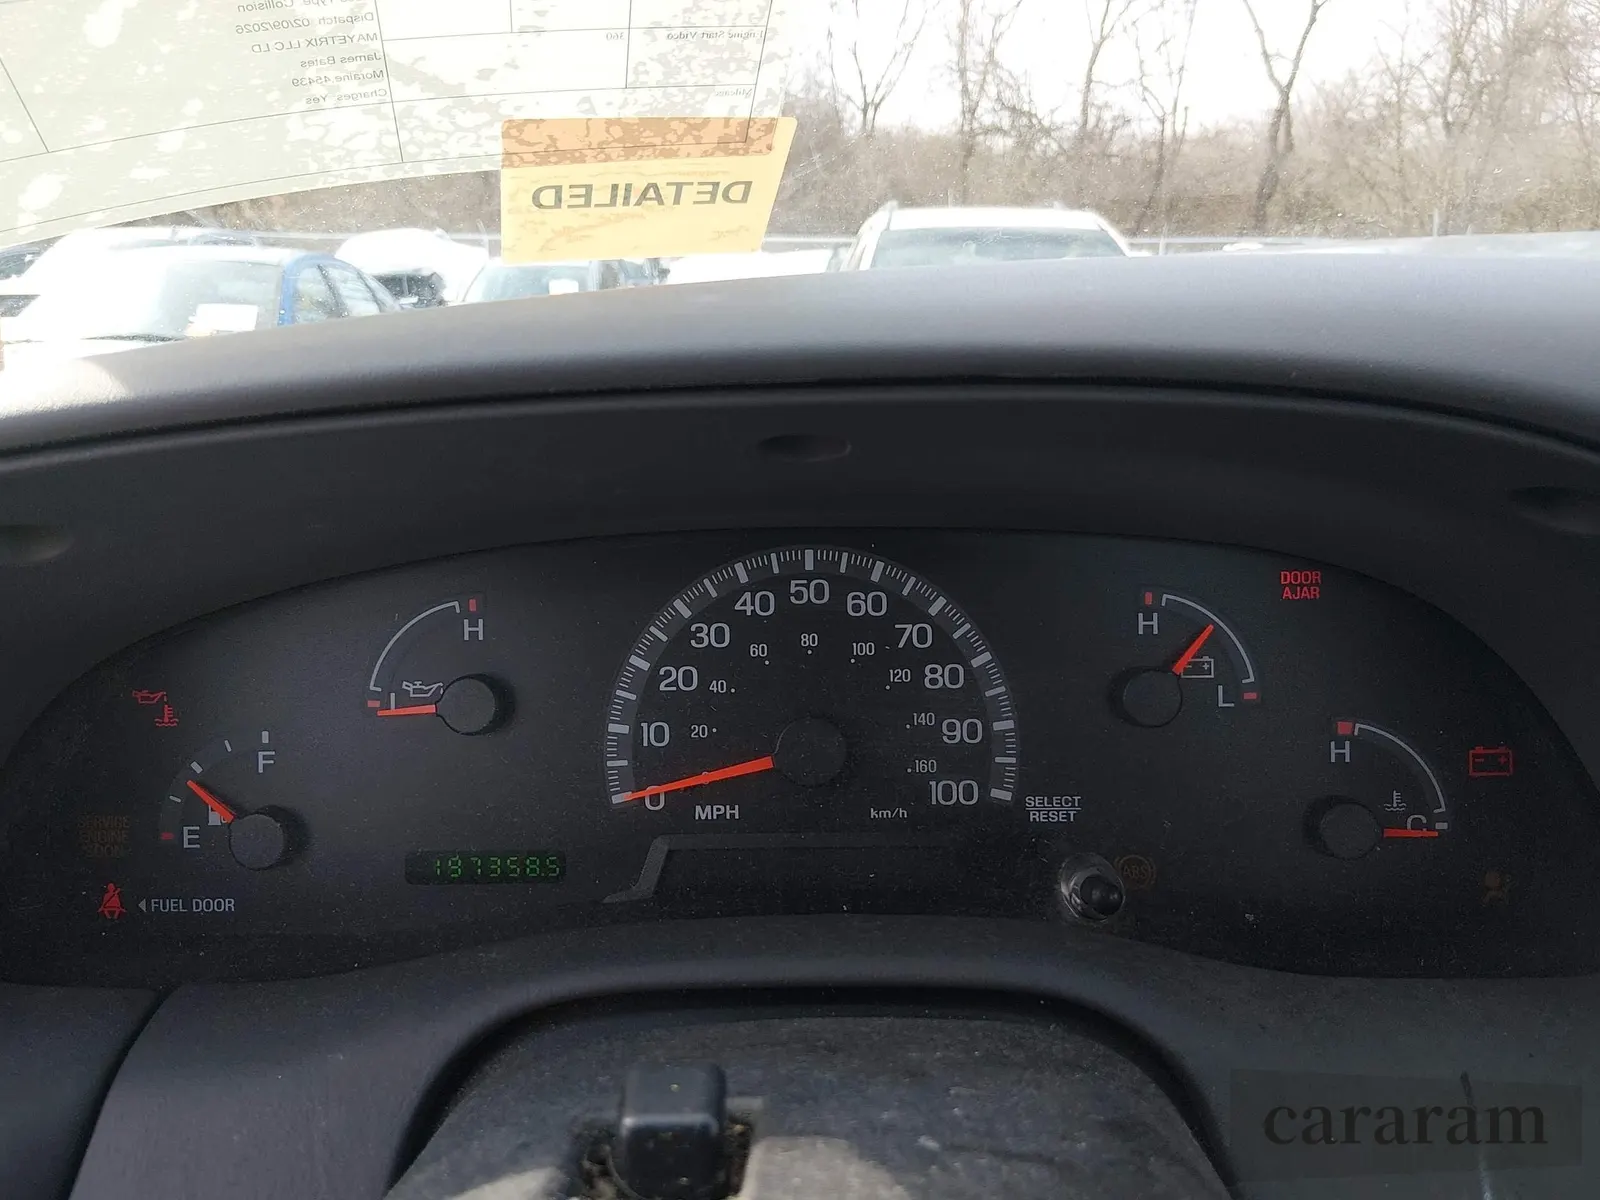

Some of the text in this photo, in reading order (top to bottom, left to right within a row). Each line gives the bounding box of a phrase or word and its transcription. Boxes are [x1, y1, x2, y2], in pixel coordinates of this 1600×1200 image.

[1280, 571, 1321, 584] DOOR
[789, 579, 830, 604] 50
[1282, 586, 1320, 599] AJAR
[734, 591, 775, 616] 40
[846, 591, 887, 617] 60
[463, 618, 483, 640] H
[1138, 612, 1158, 634] H
[690, 622, 730, 648] 30
[801, 633, 818, 647] 80
[895, 623, 933, 648] 70
[749, 643, 768, 657] 60
[852, 642, 875, 655] 100
[659, 666, 698, 691] 20
[709, 680, 727, 693] 40
[889, 669, 911, 682] 120
[924, 663, 965, 689] 80
[1217, 685, 1235, 707] L
[912, 712, 935, 726] 140
[641, 722, 670, 747] 10
[690, 724, 708, 738] 20
[942, 718, 983, 744] 90
[257, 751, 275, 773] F
[1330, 740, 1350, 763] H
[914, 760, 937, 773] 160
[645, 785, 666, 811] 0
[929, 780, 979, 806] 100
[1025, 796, 1081, 808] SELECT
[695, 805, 739, 820] MPH
[870, 807, 908, 819] km/h
[1029, 810, 1077, 822] RESET
[183, 826, 200, 848] E
[151, 899, 235, 912] FUEL DOOR
